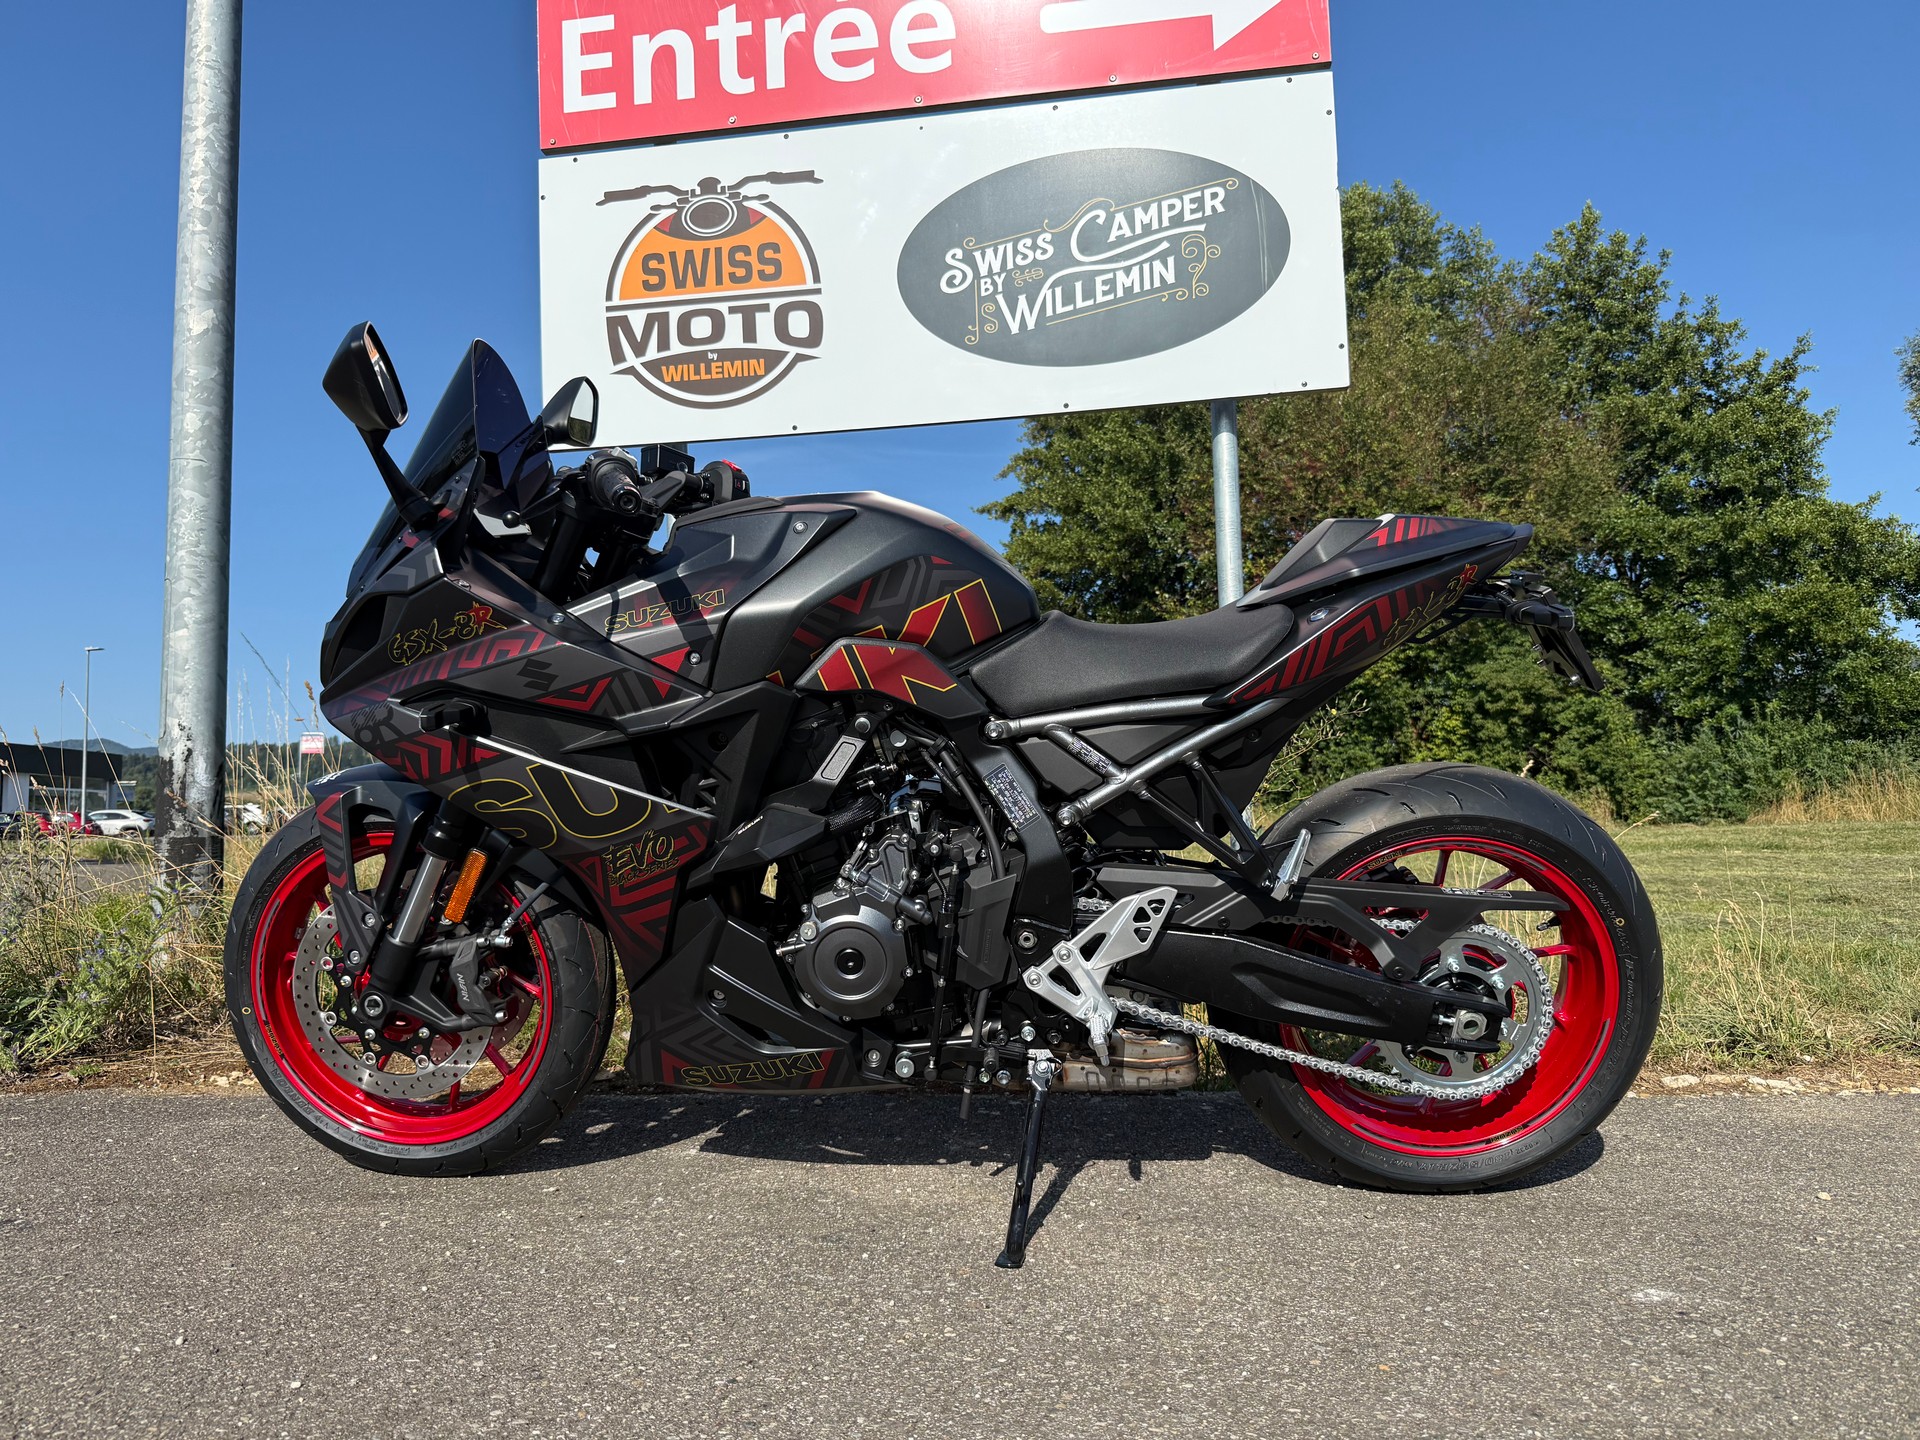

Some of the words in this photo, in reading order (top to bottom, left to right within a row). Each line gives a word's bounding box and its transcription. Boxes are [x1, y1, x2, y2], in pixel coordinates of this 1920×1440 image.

[561, 0, 957, 113] Entrée
[939, 233, 1055, 295] SWISS
[1070, 186, 1228, 262] CAMPER
[641, 242, 783, 292] SWISS
[979, 272, 1007, 297] BY
[995, 254, 1176, 335] WILLEMIN
[605, 300, 824, 367] MOTO
[708, 352, 718, 361] by
[661, 359, 765, 383] WILLEMIN
[388, 601, 508, 666] GSX-8R
[604, 588, 726, 633] SUZUKI
[448, 763, 680, 850] SU
[601, 830, 675, 877] EVO
[681, 1051, 825, 1086] SUZUKI
